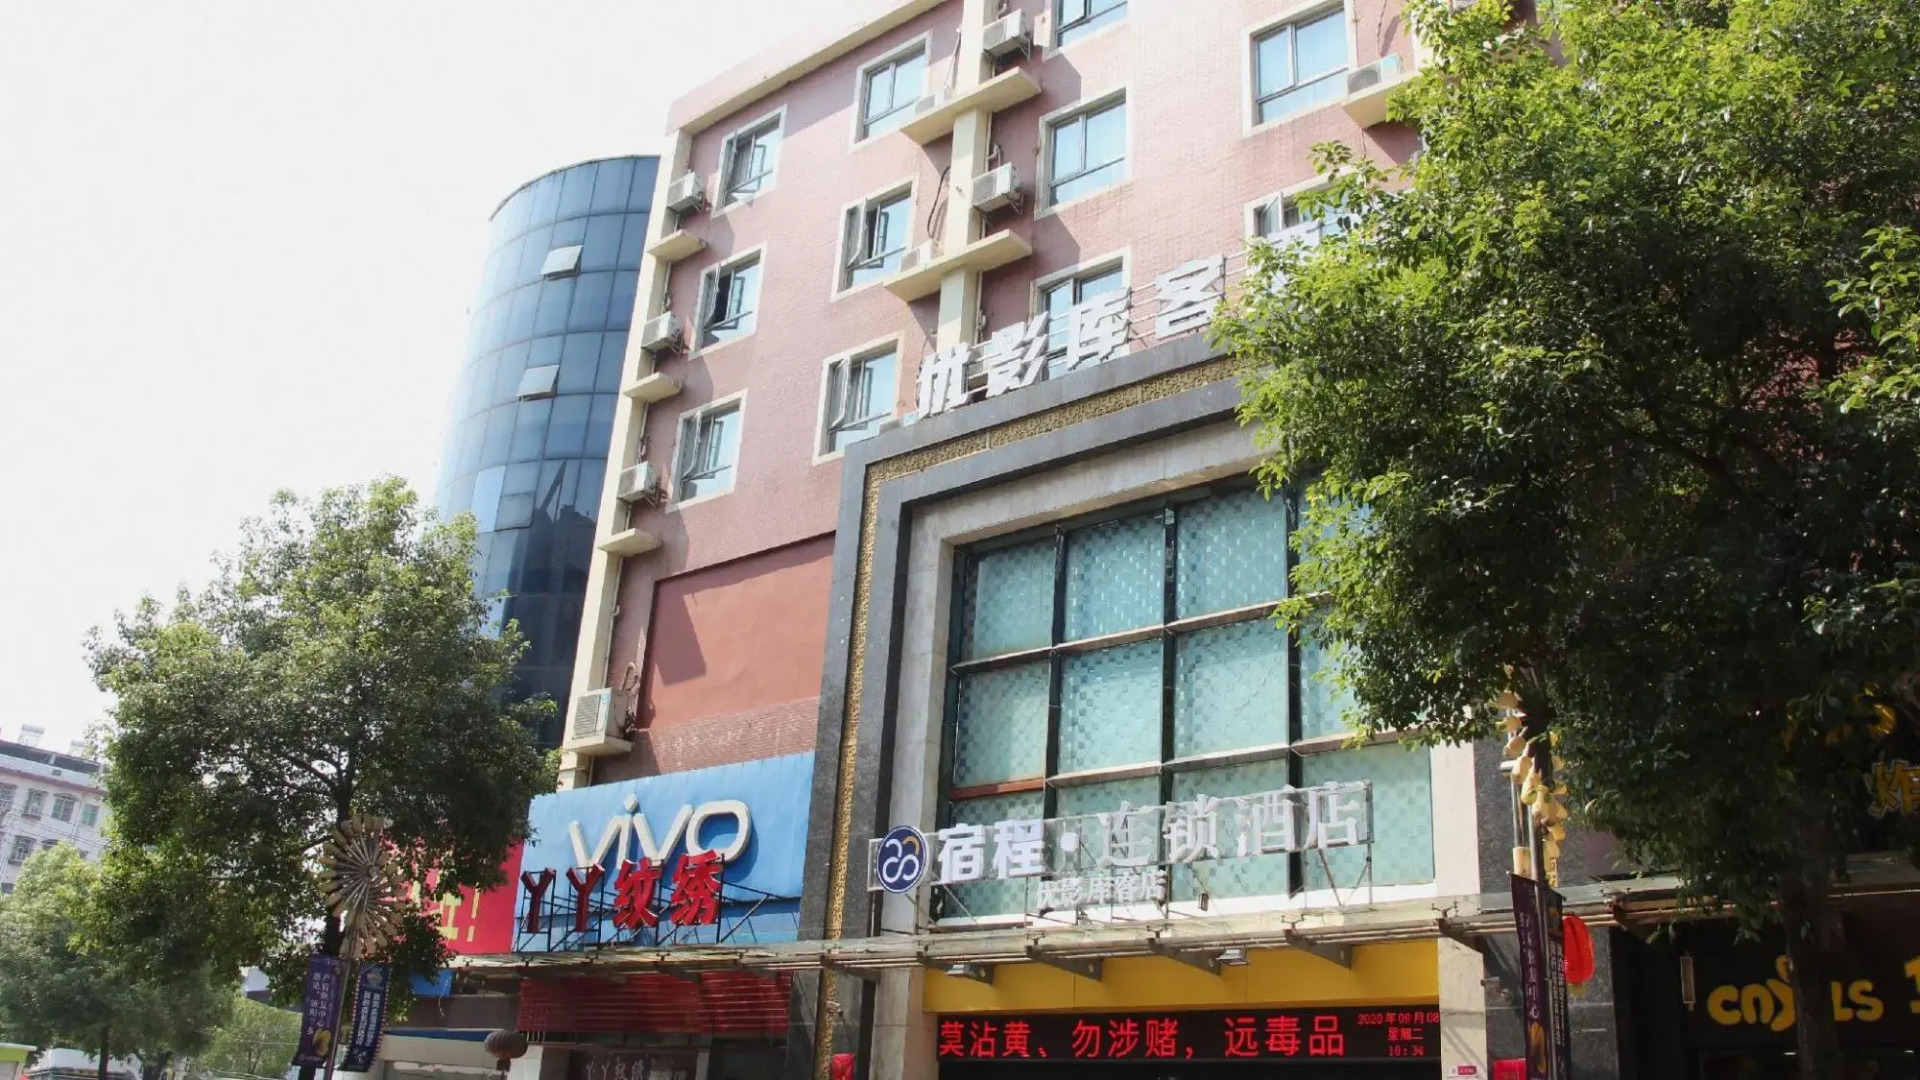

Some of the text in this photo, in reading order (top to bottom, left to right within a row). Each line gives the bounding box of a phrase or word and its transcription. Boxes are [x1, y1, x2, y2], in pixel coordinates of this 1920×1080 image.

[917, 216, 1320, 421] 优影库客
[568, 793, 752, 872] vivo
[1387, 1026, 1424, 1041] 星期二
